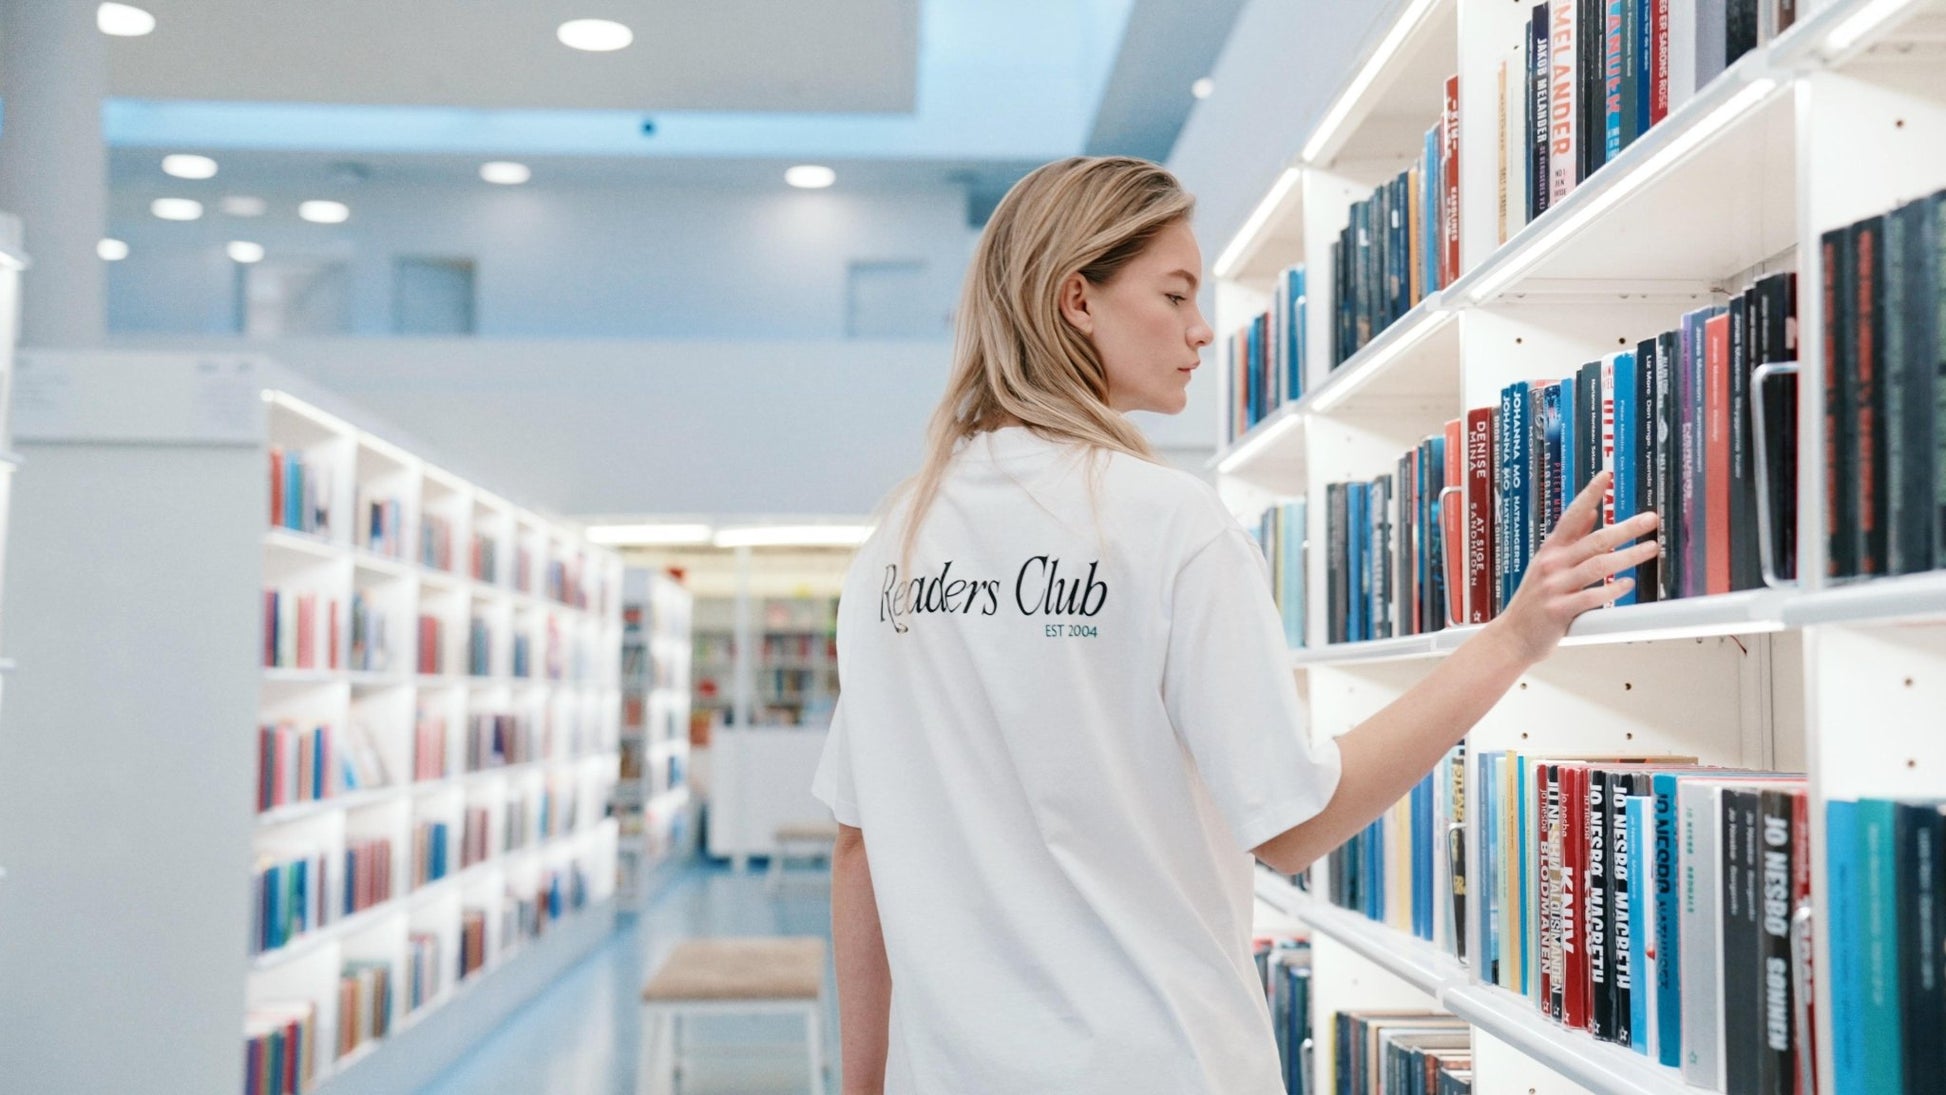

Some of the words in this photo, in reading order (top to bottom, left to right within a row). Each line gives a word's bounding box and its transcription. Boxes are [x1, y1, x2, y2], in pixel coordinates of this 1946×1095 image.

[1659, 15, 1668, 31] ER
[1536, 38, 1548, 76] JAKOB
[1659, 32, 1668, 78] SARONS
[1552, 4, 1572, 156] MELANDER
[1659, 79, 1668, 110] ROSE
[1536, 78, 1548, 143] MELANDER
[1503, 395, 1511, 463] JOHANNA
[1513, 391, 1521, 460] JOHANNA
[1469, 431, 1477, 472] MINA
[1476, 421, 1486, 479] DENISE
[1502, 467, 1511, 491] MO
[1512, 463, 1521, 489] MO
[1476, 517, 1484, 534] AT
[1513, 495, 1521, 573] NATSANGEREN
[1476, 539, 1484, 571] SIGE
[1015, 554, 1108, 617] Club
[1045, 624, 1065, 638] EST
[1068, 624, 1098, 638] 2004
[1590, 783, 1603, 806] JO
[1612, 785, 1628, 809] JO
[1590, 811, 1604, 878] NESBØ
[1613, 814, 1629, 882] NESBØ
[1763, 814, 1789, 847] JO
[1560, 866, 1574, 955] KNIV
[1591, 888, 1604, 985] MACBETH
[1614, 891, 1632, 990] MACBETH
